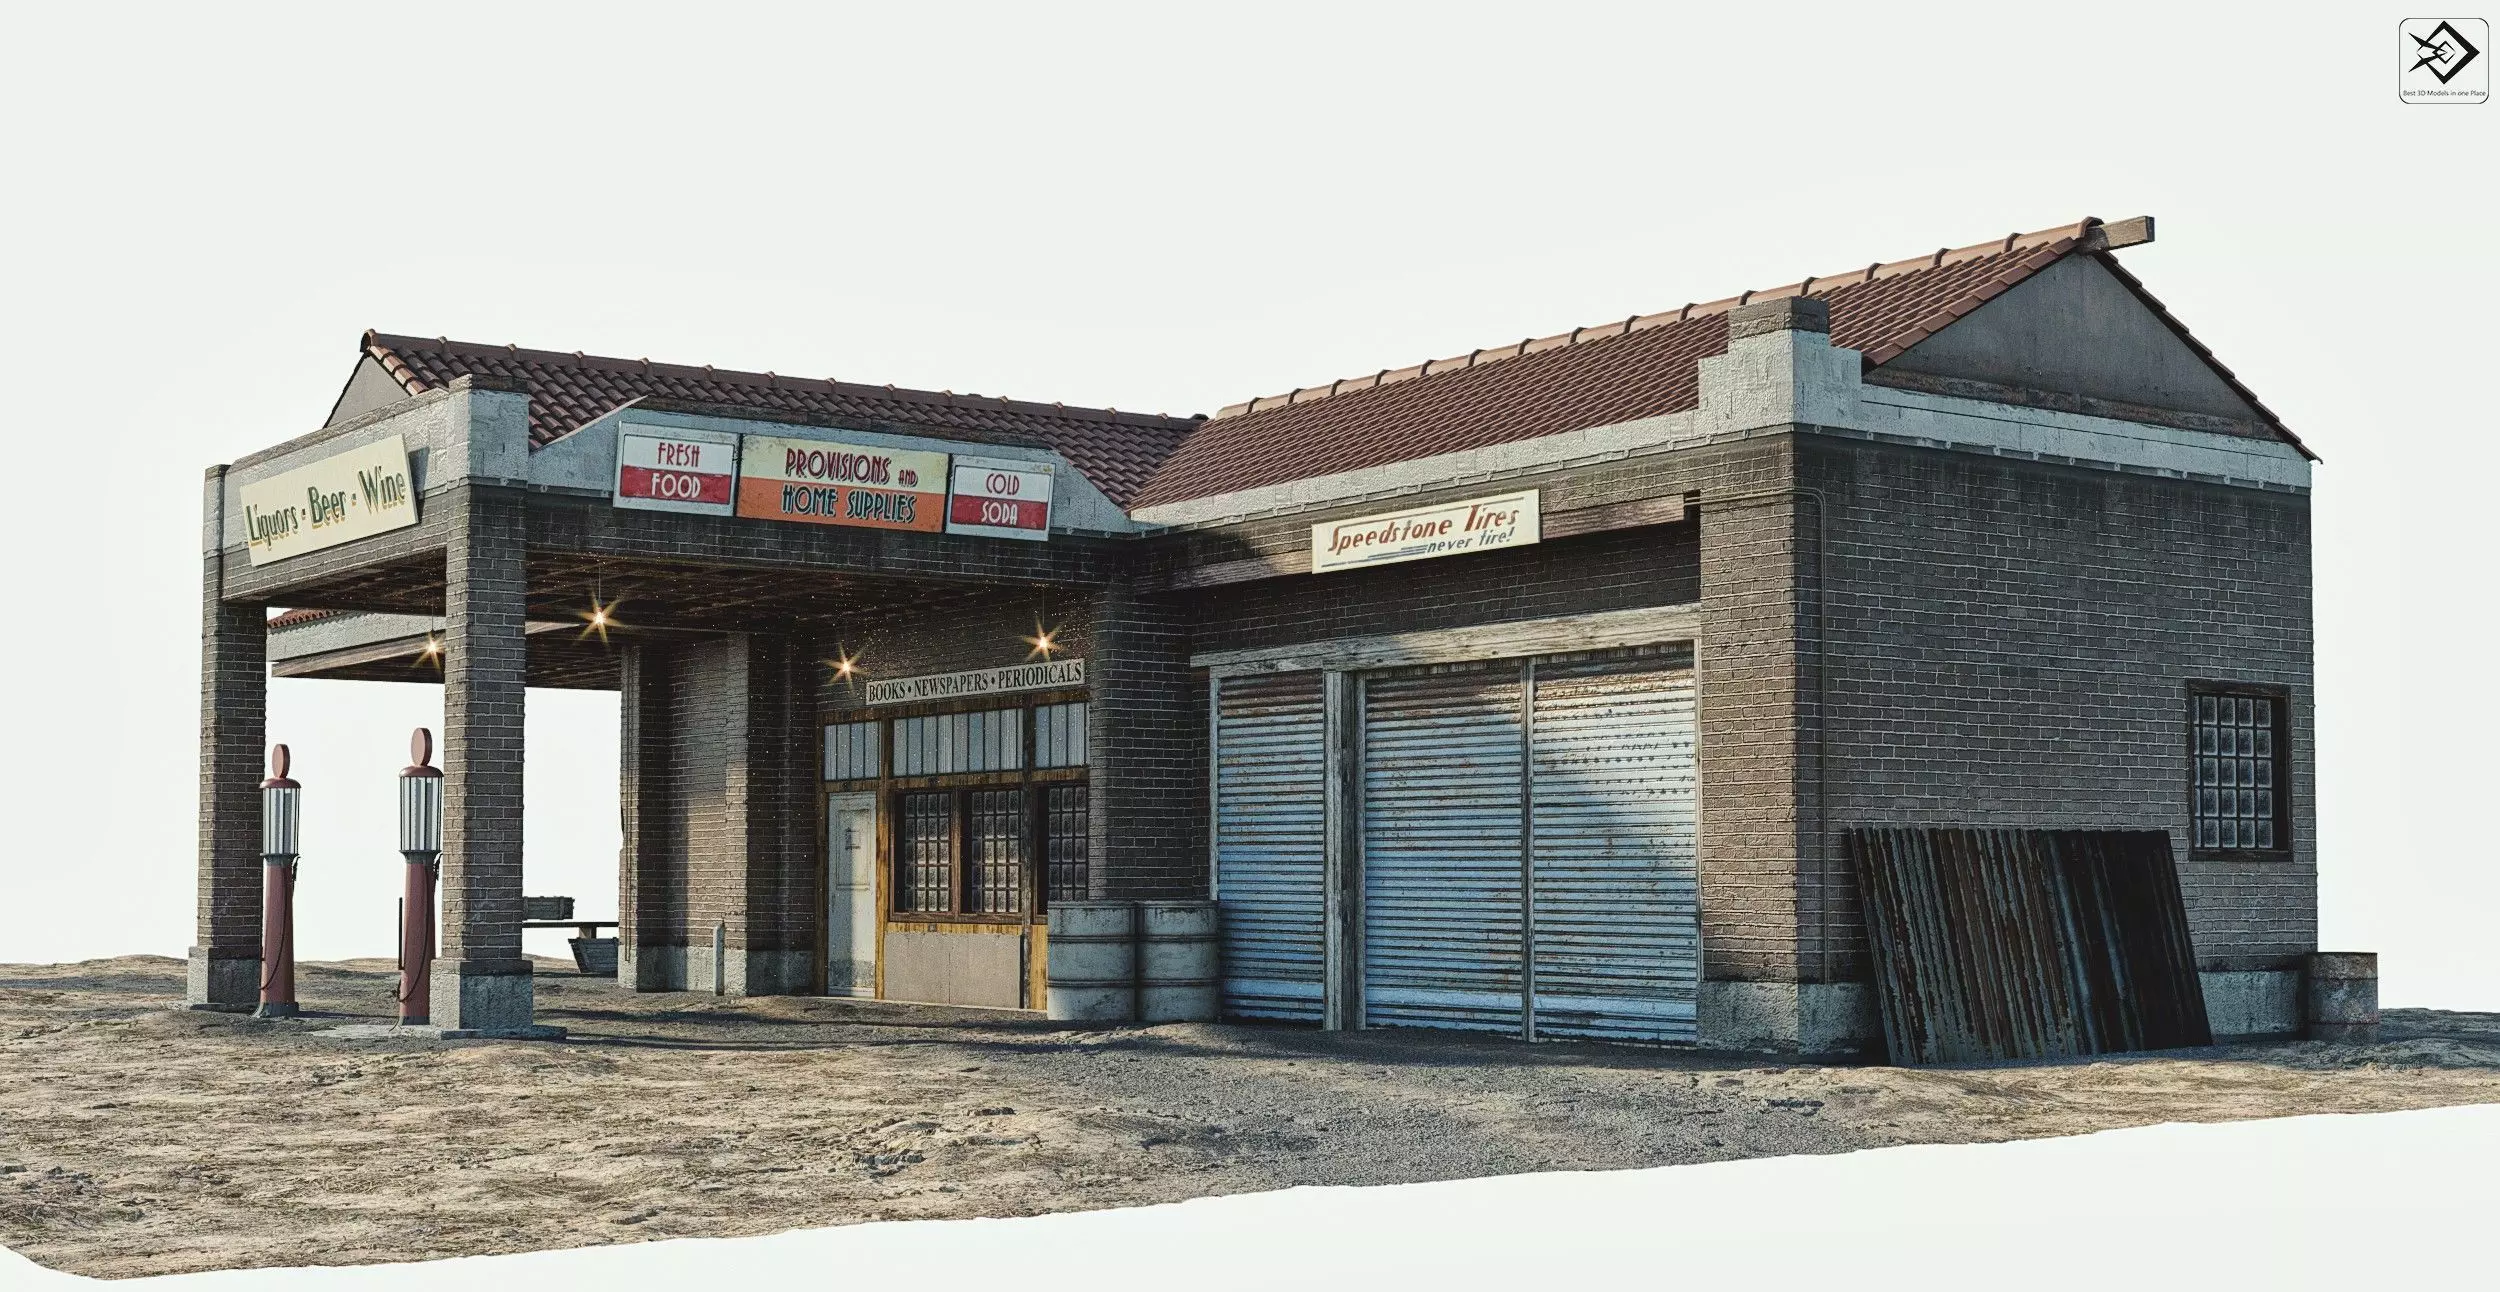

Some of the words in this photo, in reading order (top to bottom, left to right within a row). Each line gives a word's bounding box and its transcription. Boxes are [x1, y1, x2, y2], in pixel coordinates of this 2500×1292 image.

[657, 442, 700, 468] FRESH
[786, 448, 892, 484] PROVISIONS
[898, 469, 919, 488] AND
[651, 473, 701, 500] FOOD
[985, 473, 1020, 496] COLD
[246, 504, 299, 550] Liquors
[308, 486, 347, 529] Beer
[358, 465, 406, 515] Wine
[781, 484, 839, 517] HOME
[846, 490, 916, 523] SUPPLIES
[981, 502, 1018, 526] SODA
[1327, 518, 1452, 555] Speedstone
[1464, 504, 1520, 533] Tires
[1426, 537, 1476, 554] never
[1479, 526, 1516, 546] tire!
[868, 680, 906, 701] BOOKS
[914, 672, 988, 698] NEWSPAPERS
[998, 662, 1083, 689] PERIODICALS
